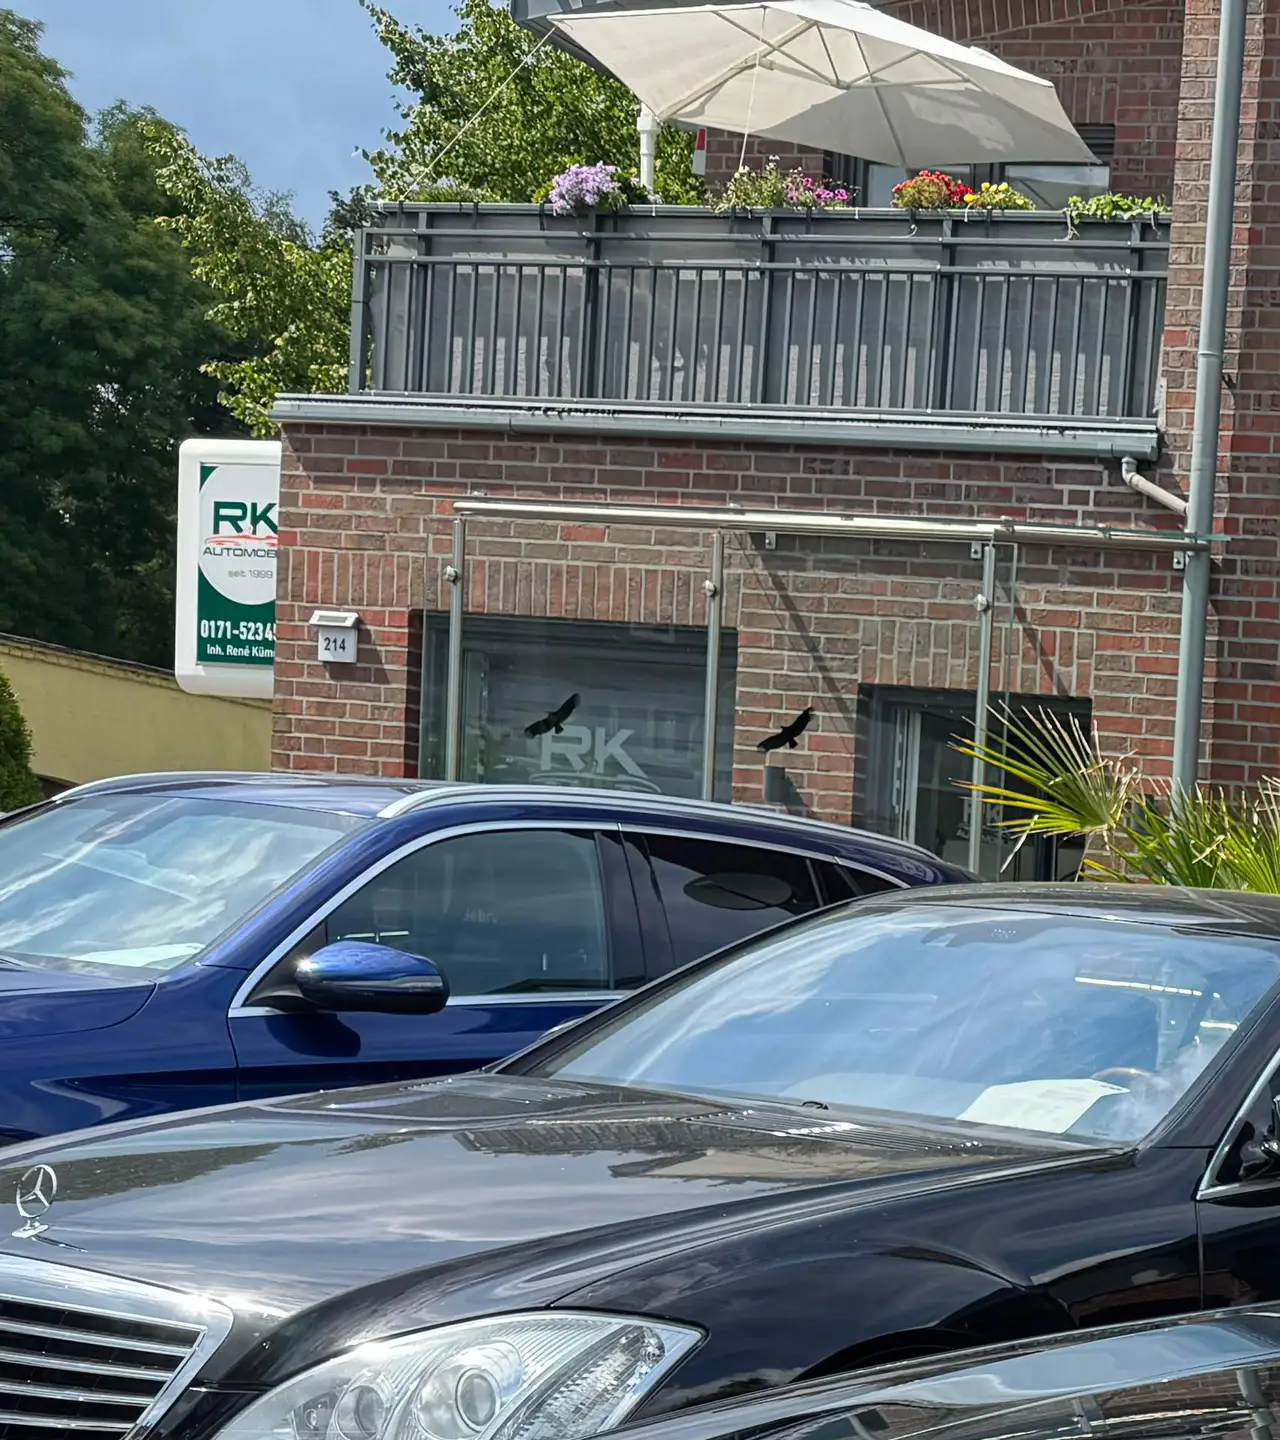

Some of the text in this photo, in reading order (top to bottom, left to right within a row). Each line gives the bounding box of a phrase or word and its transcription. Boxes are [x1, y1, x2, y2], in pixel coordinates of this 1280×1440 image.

[213, 501, 277, 535] RK
[203, 547, 278, 558] AUTOMOB
[228, 569, 273, 578] seit 1999
[207, 643, 275, 658] Inh. René Küm
[324, 636, 346, 652] 214
[541, 724, 649, 779] RK
